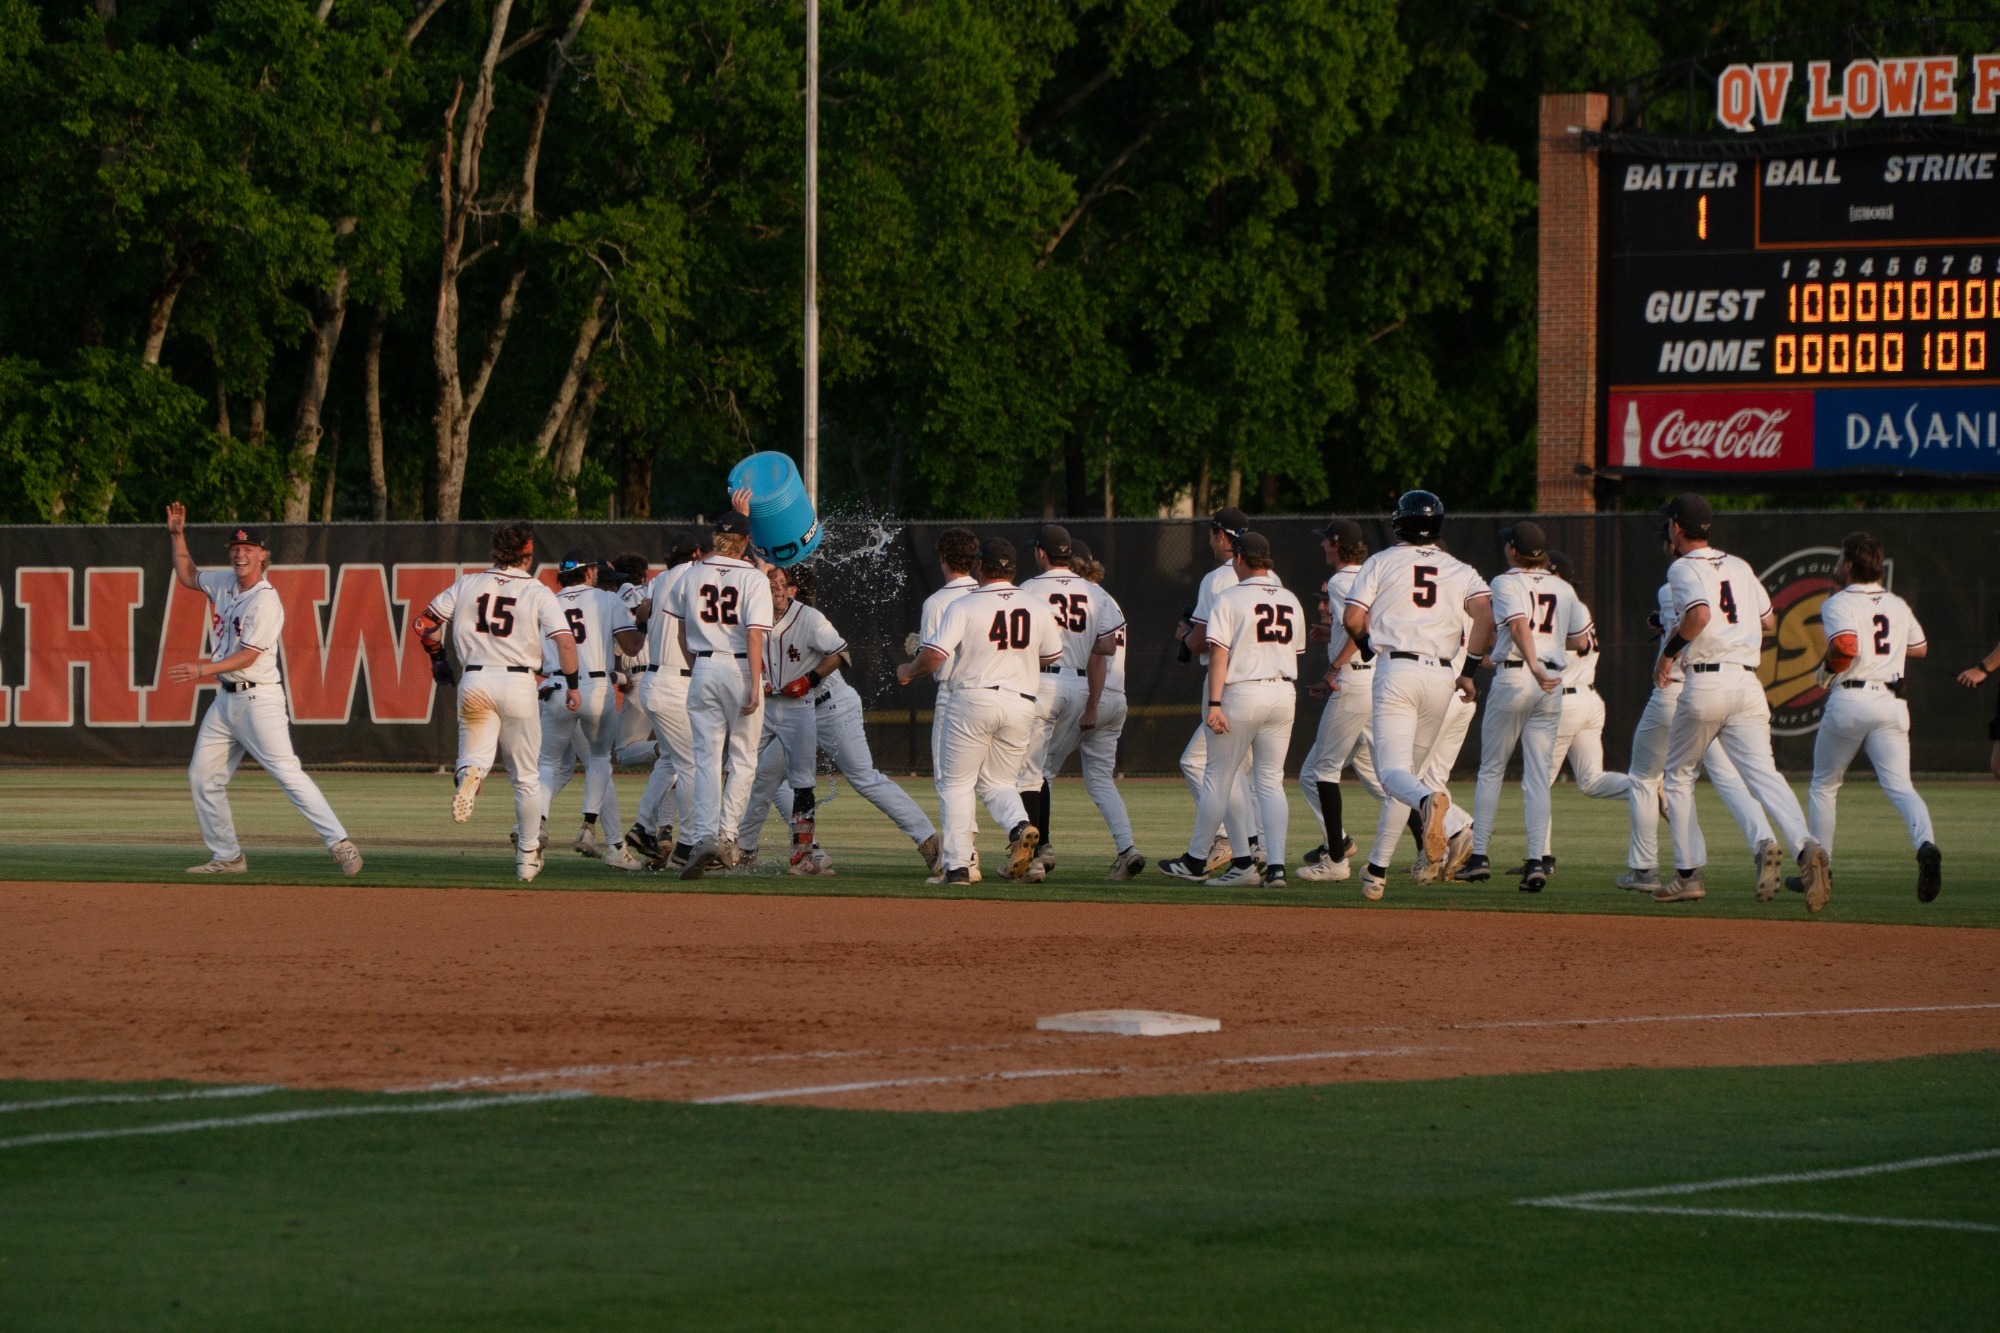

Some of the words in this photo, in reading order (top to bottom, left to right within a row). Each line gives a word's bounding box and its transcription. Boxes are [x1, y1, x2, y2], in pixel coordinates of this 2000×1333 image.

[1717, 61, 1793, 132] QV
[1806, 55, 1958, 122] LOWE
[1623, 161, 1738, 191] BATTER
[1765, 157, 1841, 187] BALL
[1884, 152, 1997, 183] STRIKE
[1698, 194, 1707, 240] 1
[1782, 259, 1792, 279] 1
[1806, 258, 1821, 278] 2
[1833, 258, 1847, 278] 3
[1859, 257, 1874, 277] 4
[1886, 256, 1900, 276] 5
[1914, 255, 1928, 275] 6
[1942, 255, 1955, 275] 7
[1969, 254, 1983, 275] 8
[1644, 289, 1765, 323] GUEST
[1657, 338, 1765, 374] HOME
[1650, 407, 1792, 459] Coca-Cola
[1845, 400, 1997, 459] DASANI
[700, 583, 739, 625] 32
[1412, 565, 1438, 608] 5
[1719, 580, 1738, 624] 4
[476, 593, 517, 638] 15
[988, 607, 1031, 651] 40
[1049, 593, 1088, 633] 35
[1254, 603, 1294, 645] 25
[1872, 613, 1890, 655] 2
